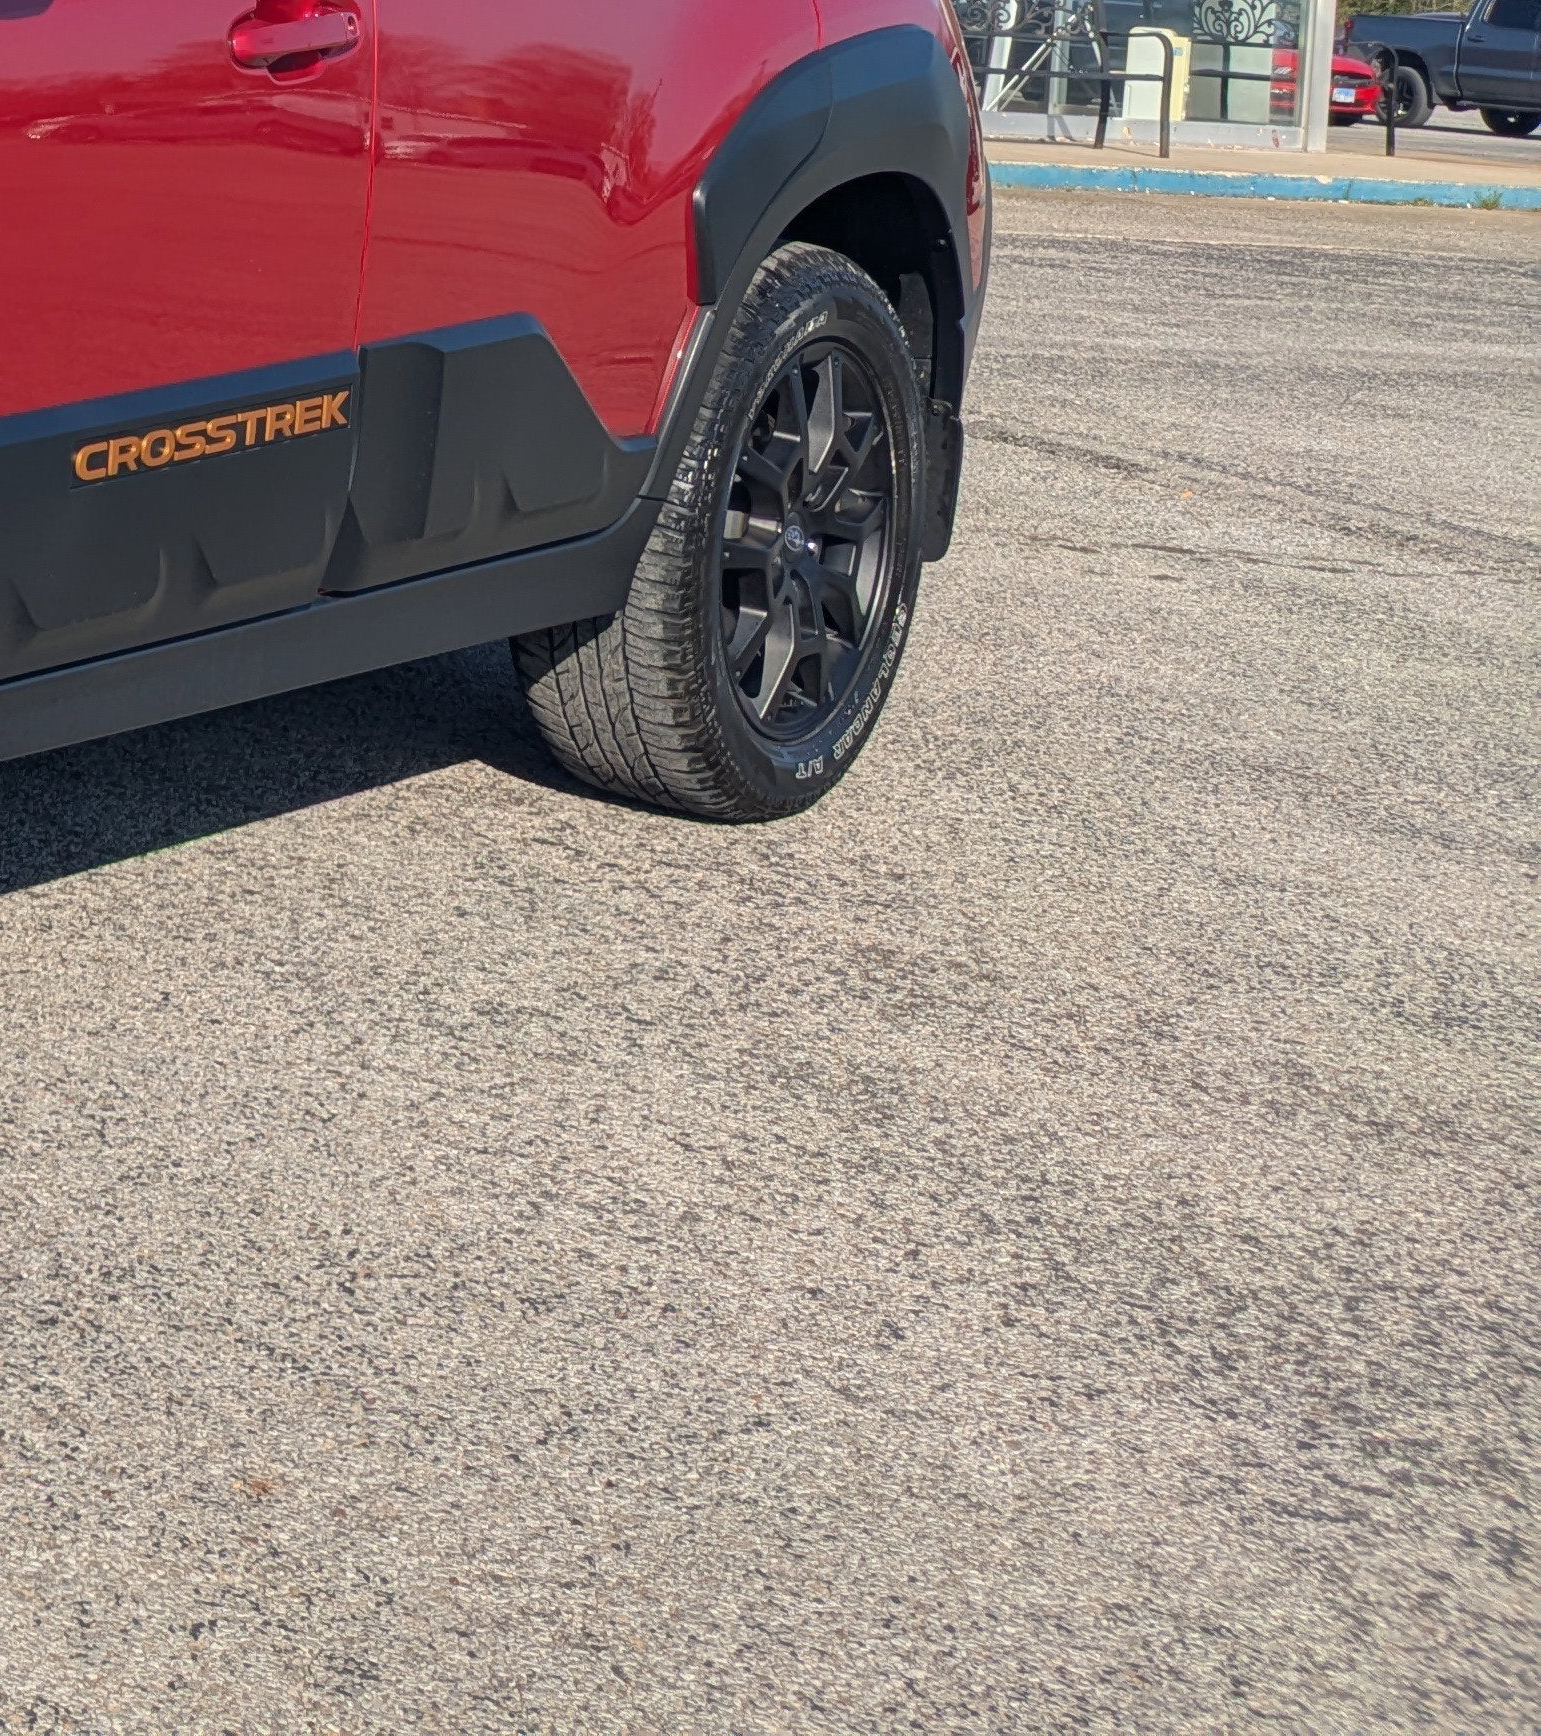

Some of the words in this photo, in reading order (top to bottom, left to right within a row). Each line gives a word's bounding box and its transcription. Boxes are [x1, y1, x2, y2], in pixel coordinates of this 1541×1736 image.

[74, 390, 350, 481] CROSSTREK
[833, 602, 907, 760] GEOLANDAR
[795, 755, 824, 779] A/T
